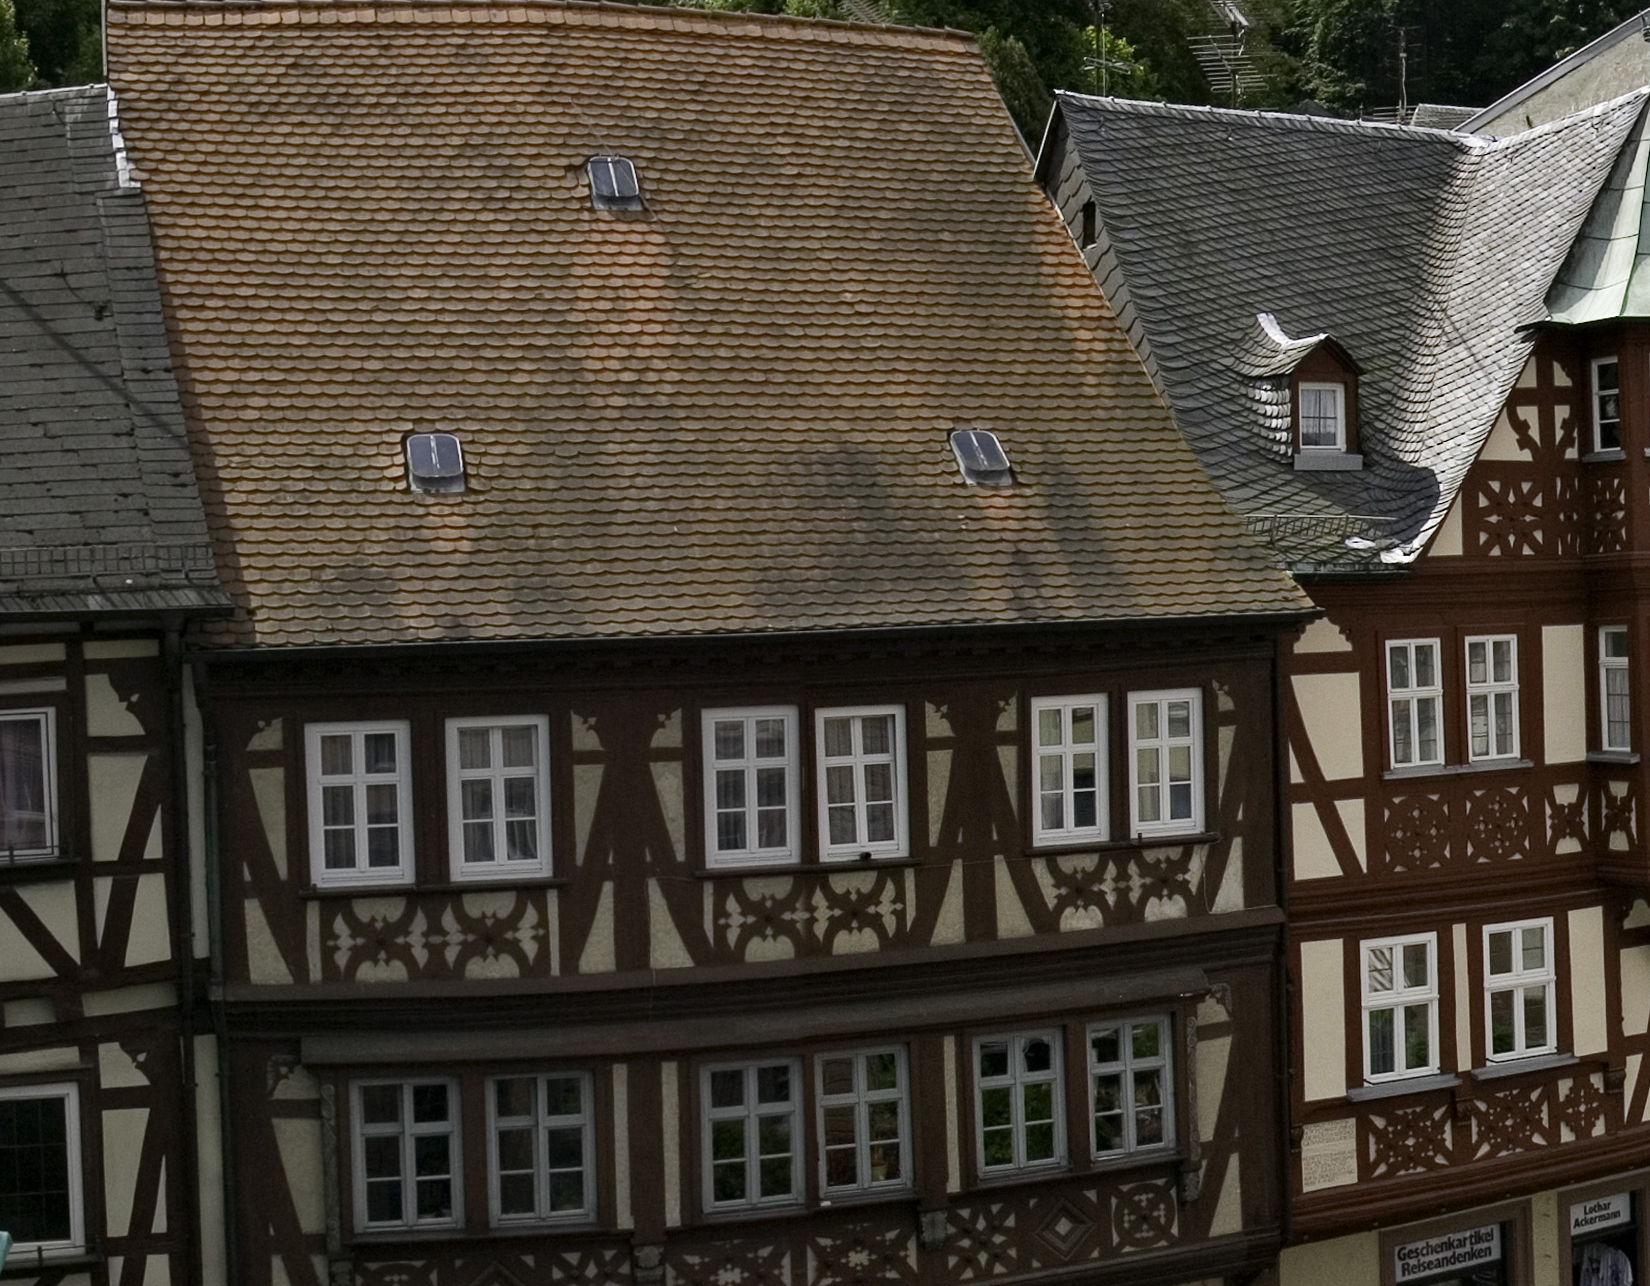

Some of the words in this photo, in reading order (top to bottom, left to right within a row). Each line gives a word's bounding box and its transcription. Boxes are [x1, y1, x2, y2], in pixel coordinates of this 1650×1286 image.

[1573, 1209, 1621, 1229] Ackermann
[1583, 1201, 1612, 1215] Lothar
[1397, 1228, 1494, 1261] Geschenkartikel
[1401, 1246, 1491, 1278] Reiseandenken
